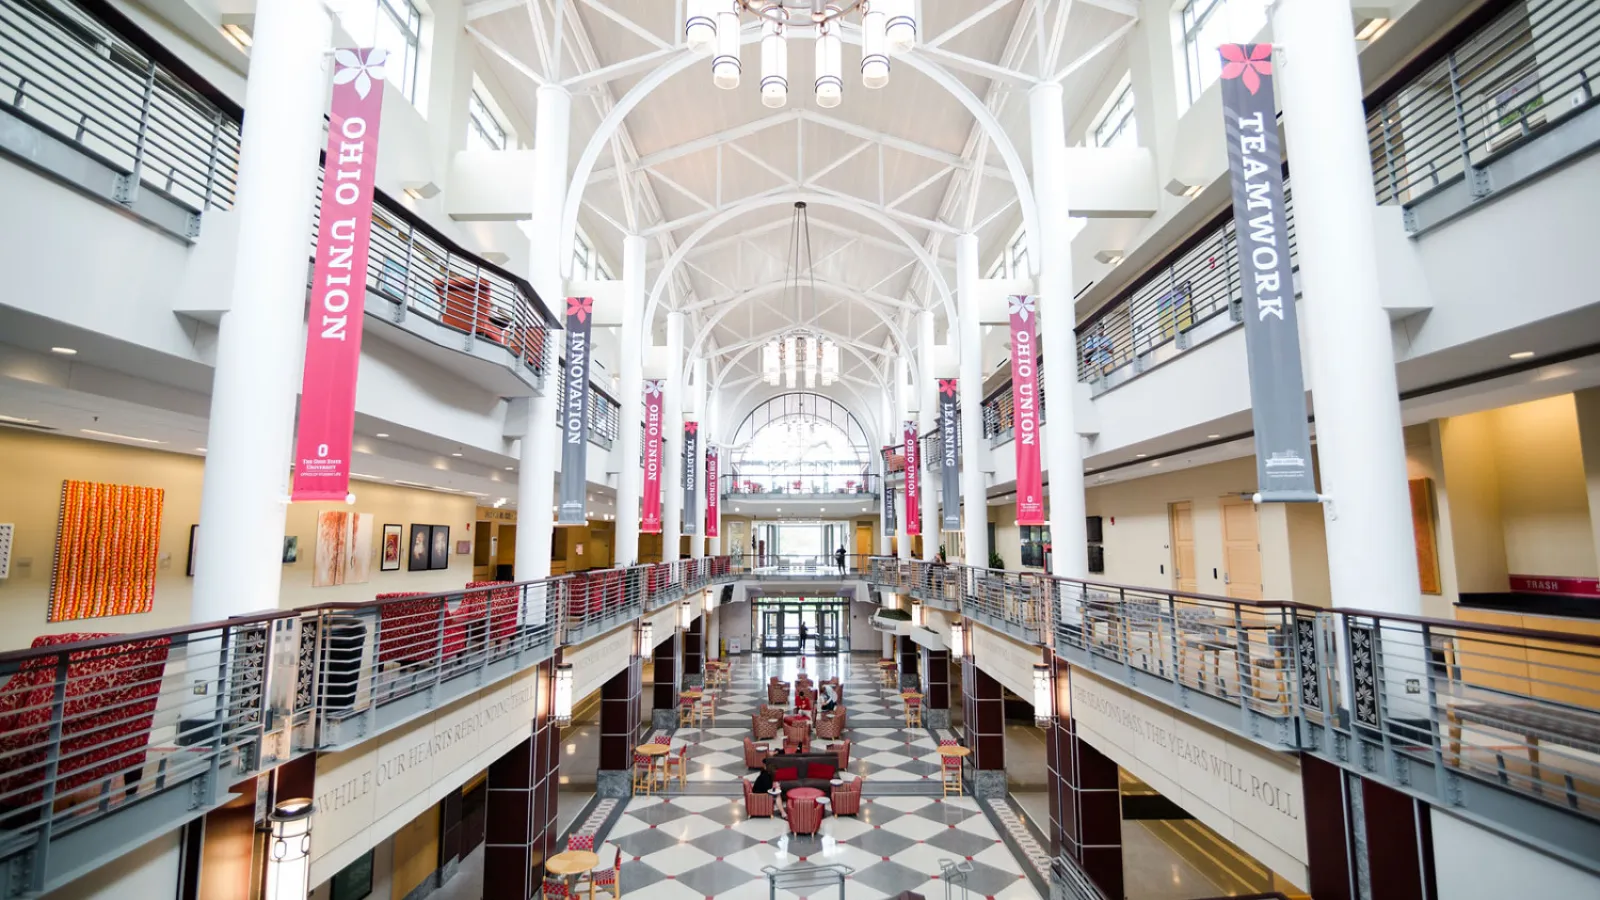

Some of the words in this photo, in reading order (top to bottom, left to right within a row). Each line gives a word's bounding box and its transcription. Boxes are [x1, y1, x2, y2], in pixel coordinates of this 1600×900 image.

[335, 116, 367, 206] OHIO
[1238, 111, 1284, 322] TEAMWORK
[321, 216, 356, 341] UNION
[1017, 330, 1031, 377] OHIO
[567, 331, 585, 445] INNOVATION
[648, 404, 659, 436] OHIO
[1019, 383, 1034, 445] UNION
[648, 439, 658, 481] UNION
[686, 438, 695, 491] TRADITION
[944, 403, 955, 467] LEARNING
[1526, 580, 1558, 590] TRASH
[317, 769, 372, 815] WHILE
[375, 753, 406, 788] OUR
[407, 727, 453, 770] HEARTS
[1145, 720, 1167, 748] THE
[1168, 731, 1208, 773] YEARS
[1210, 753, 1247, 793] WILL
[1250, 773, 1298, 820] ROLL
